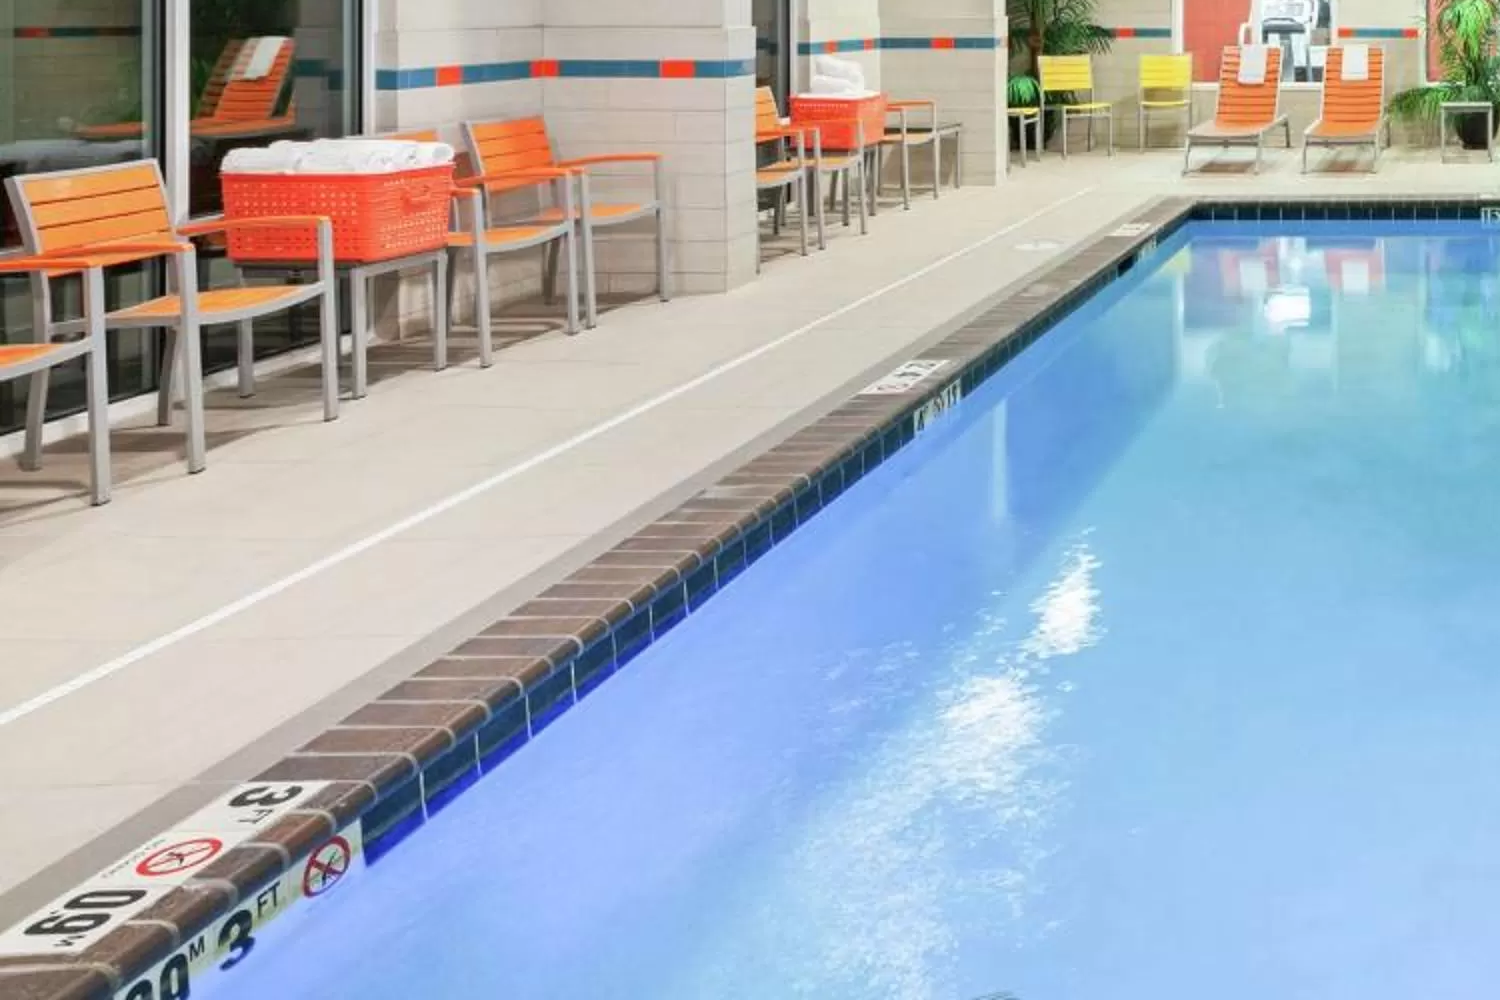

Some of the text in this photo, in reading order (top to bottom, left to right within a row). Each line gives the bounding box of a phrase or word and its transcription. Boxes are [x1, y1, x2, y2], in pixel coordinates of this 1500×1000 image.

[228, 785, 303, 807] 3
[189, 936, 205, 963] M
[216, 908, 256, 972] 3
[256, 881, 281, 919] FT
